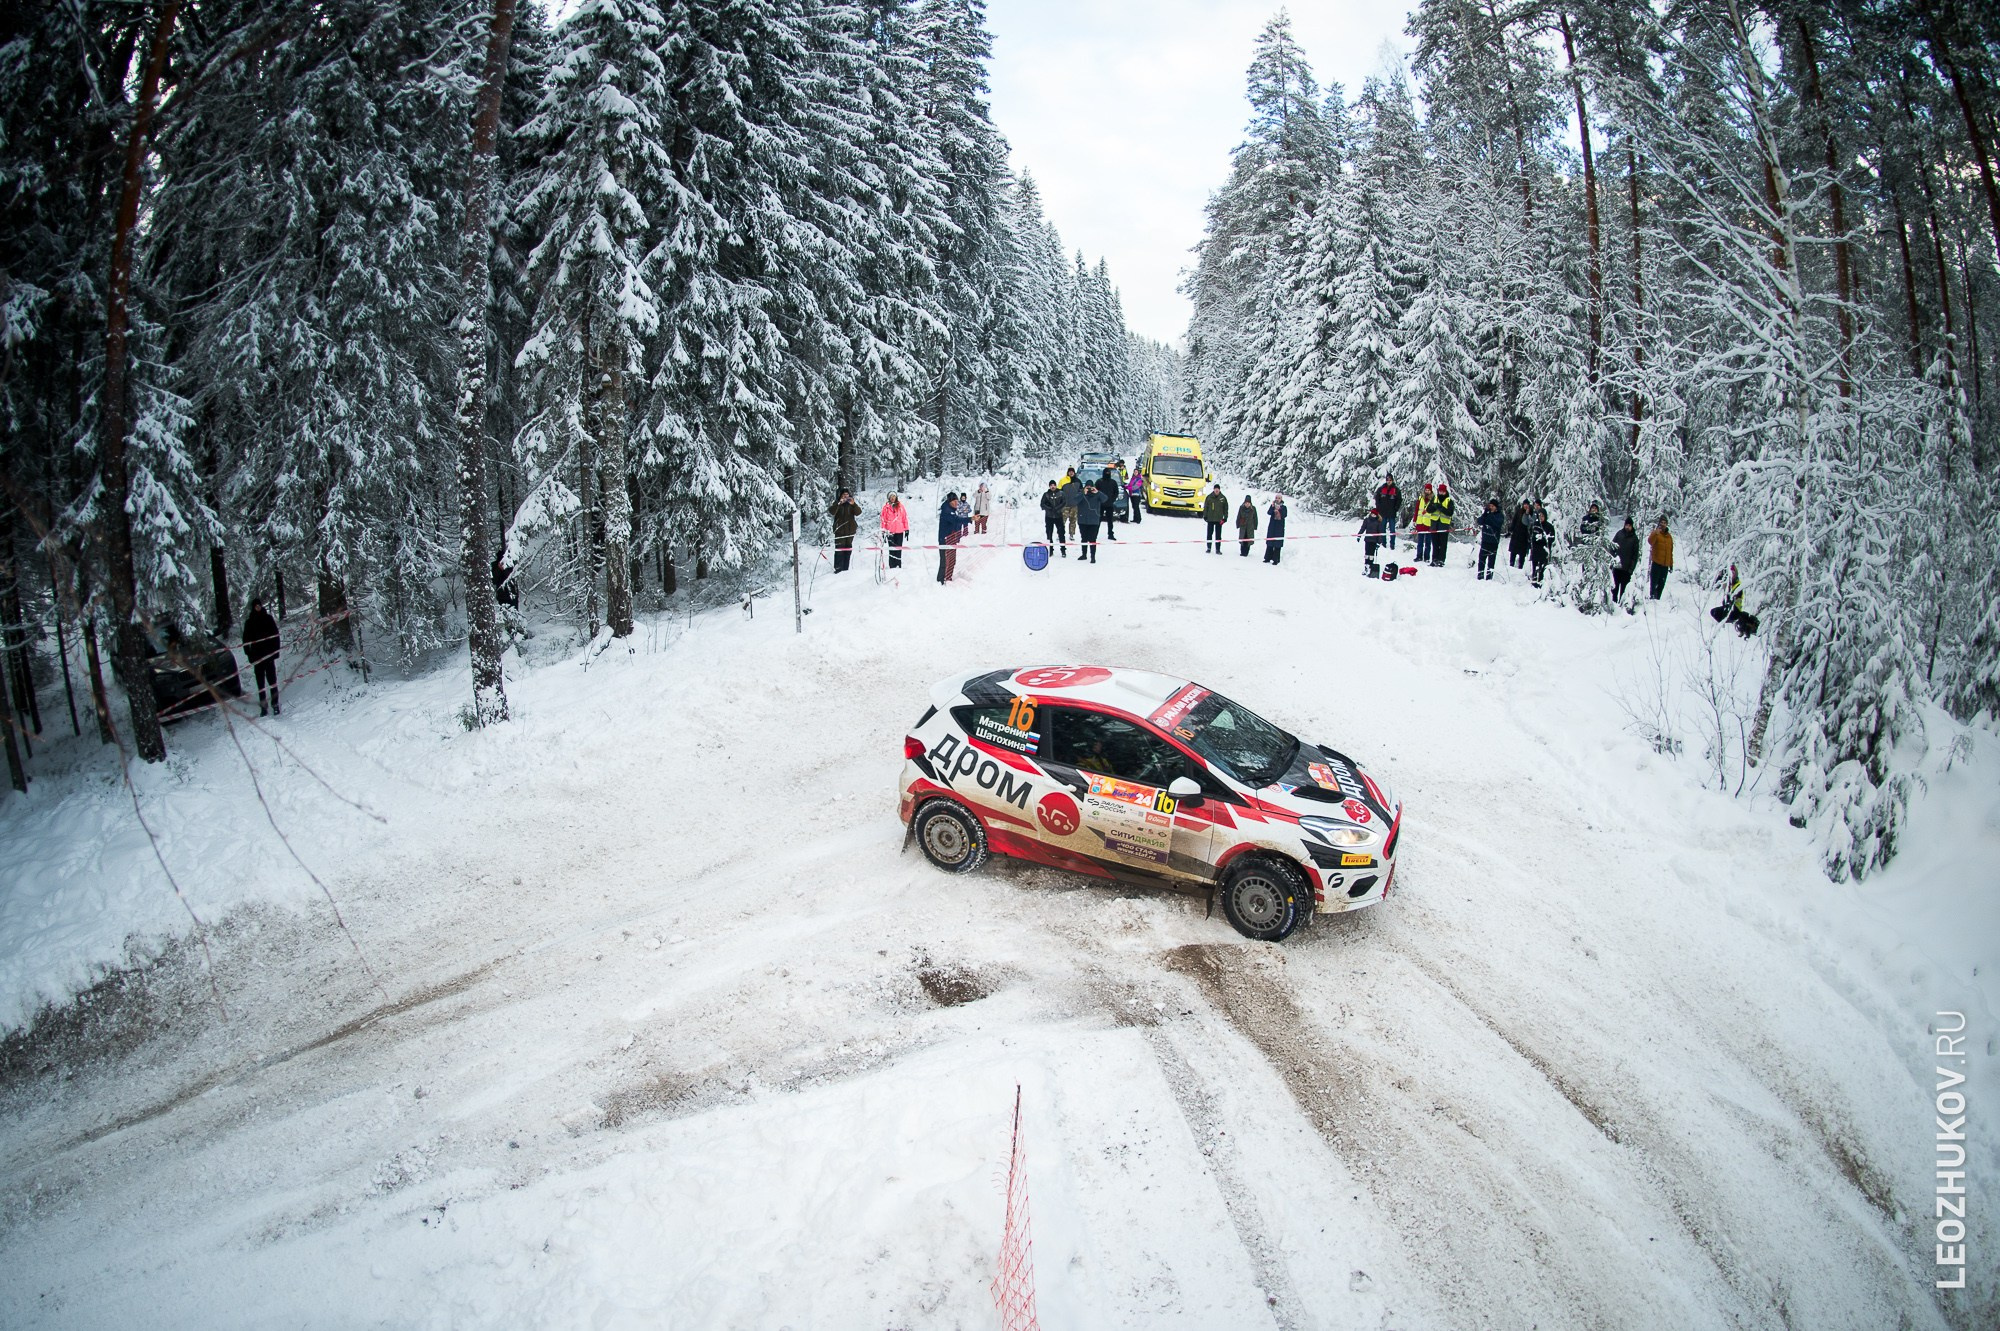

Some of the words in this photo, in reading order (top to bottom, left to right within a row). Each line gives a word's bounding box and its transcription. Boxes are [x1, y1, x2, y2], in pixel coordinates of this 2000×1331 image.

[1007, 695, 1038, 732] 16
[978, 715, 1029, 740] Матренин
[1173, 726, 1195, 742] 16
[975, 726, 1026, 752] Шатохина
[1134, 793, 1152, 806] 24
[1110, 829, 1166, 848] СИТИДРАЙВ
